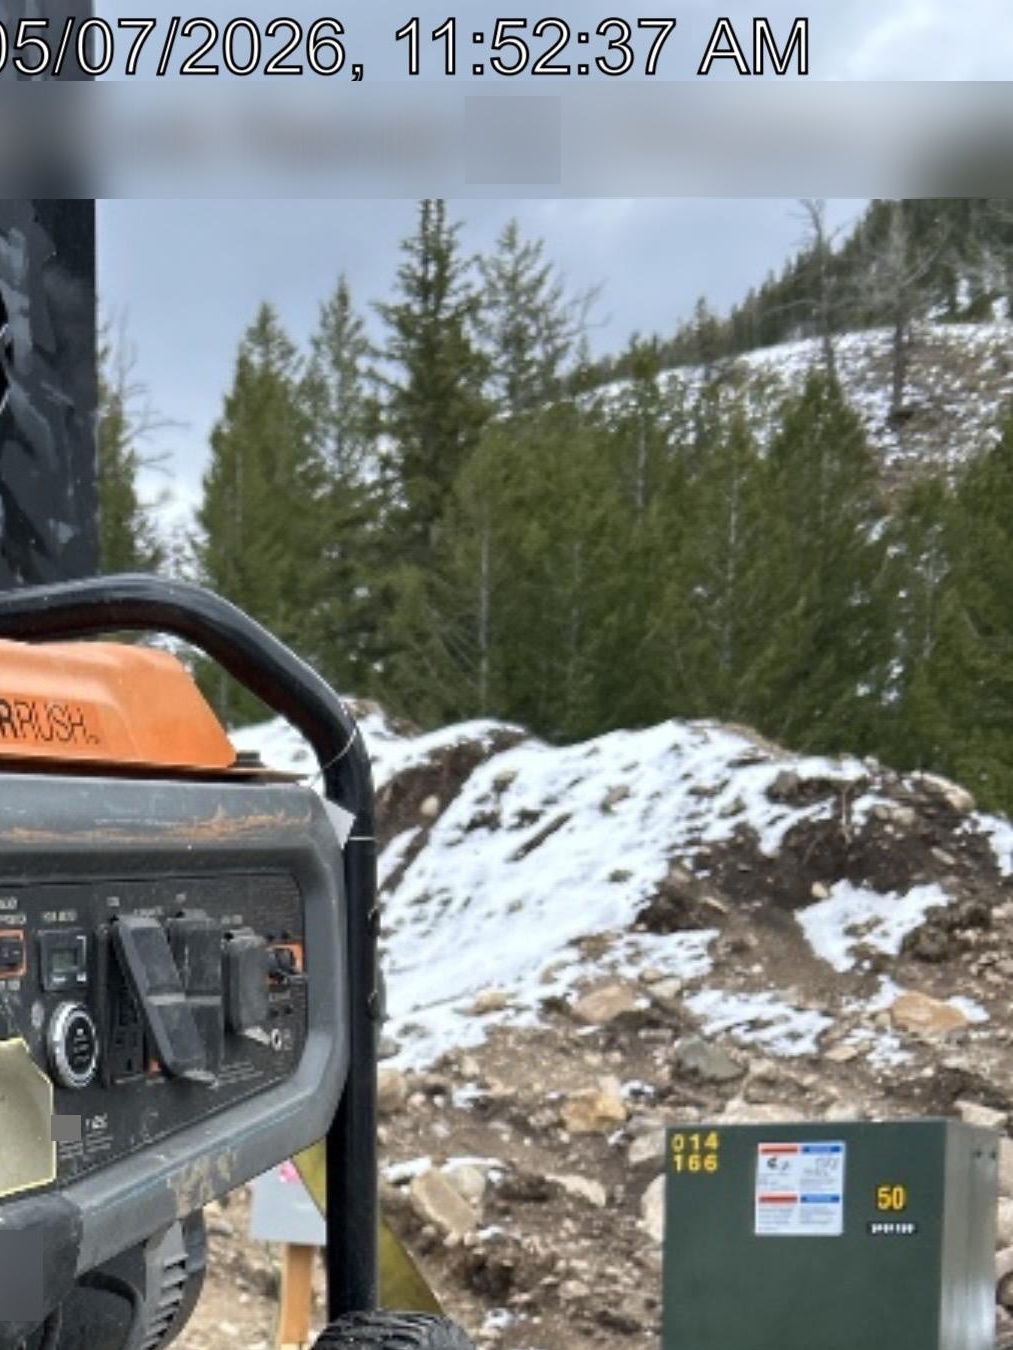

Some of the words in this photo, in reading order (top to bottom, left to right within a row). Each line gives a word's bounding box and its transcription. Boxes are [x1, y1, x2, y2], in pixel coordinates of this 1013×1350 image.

[671, 1131, 718, 1152] 014
[673, 1154, 718, 1173] 166
[877, 1186, 905, 1210] 50
